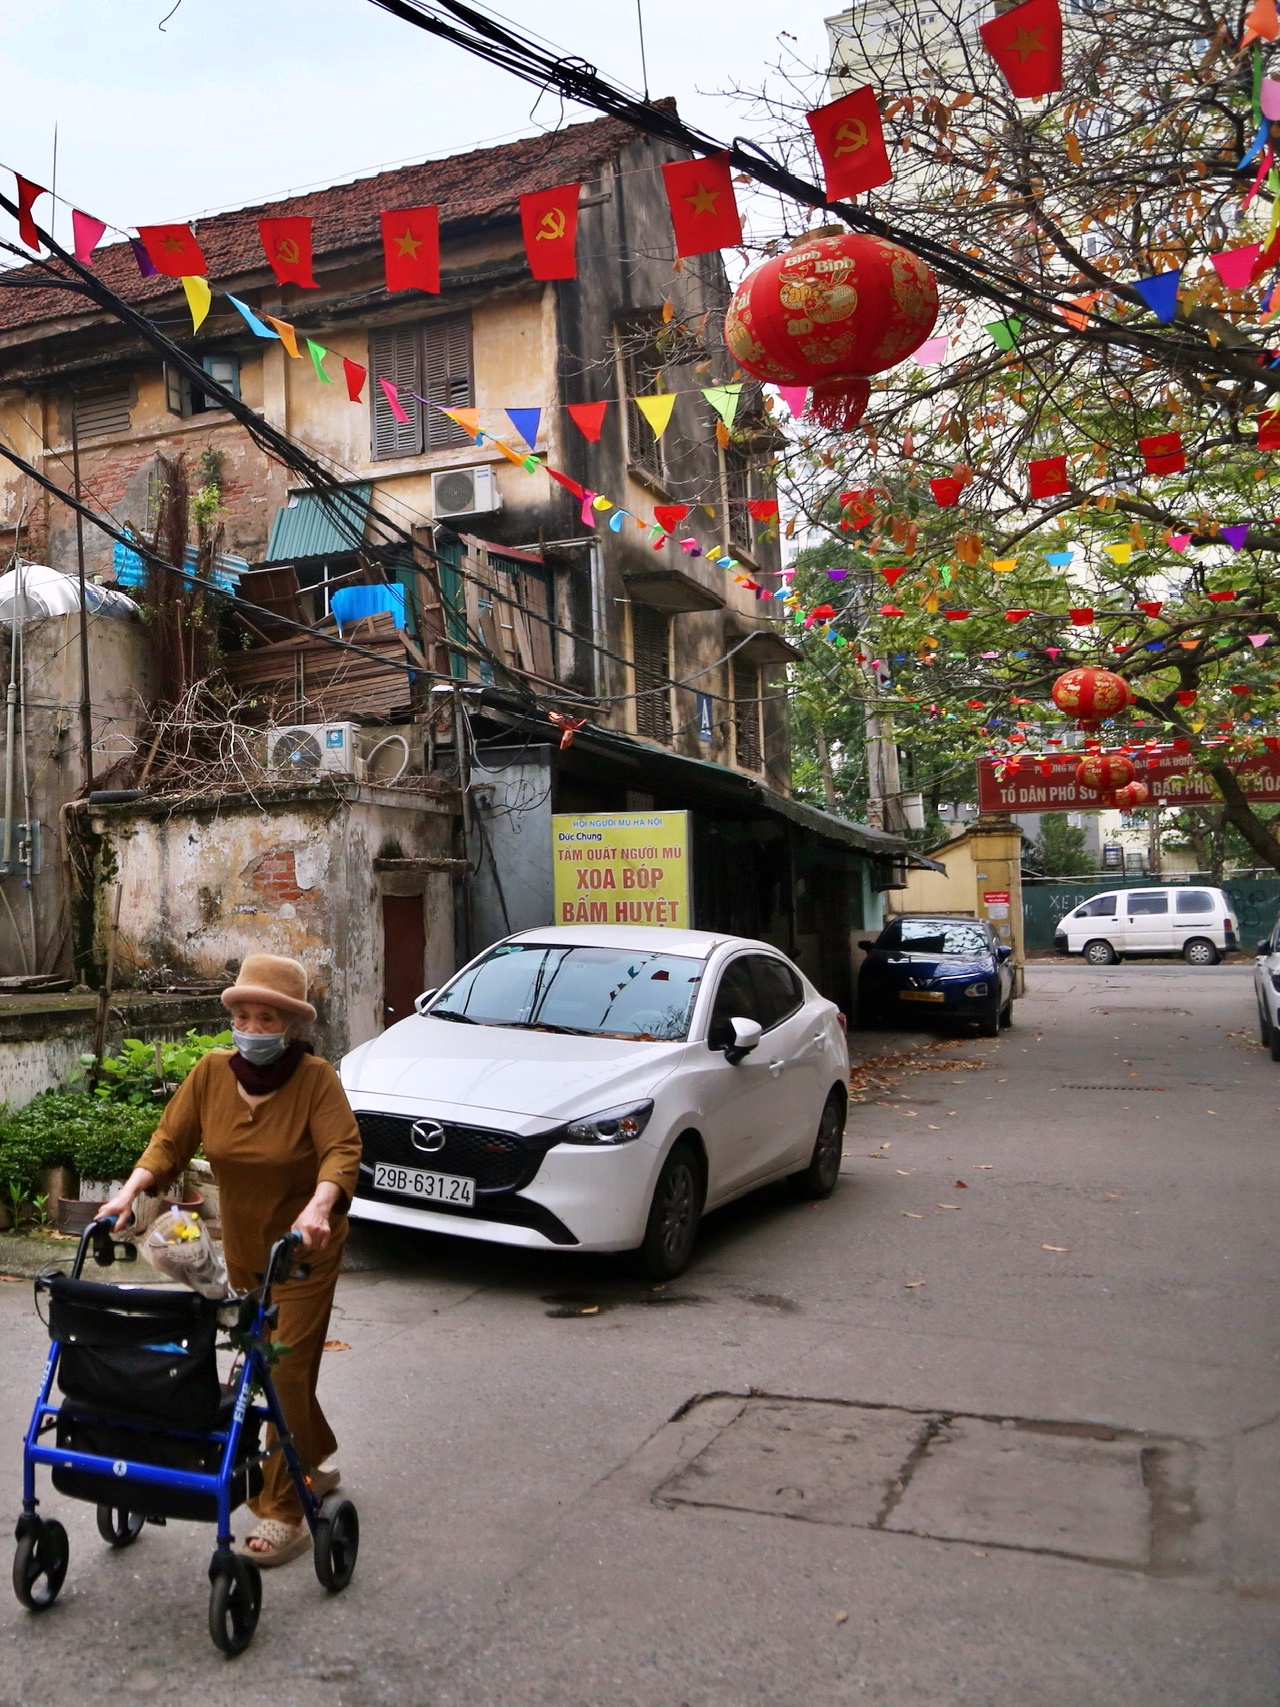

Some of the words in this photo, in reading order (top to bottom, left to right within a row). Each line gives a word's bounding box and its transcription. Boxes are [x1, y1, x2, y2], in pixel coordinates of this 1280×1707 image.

[1000, 782, 1016, 803] TỔ
[1020, 785, 1046, 803] DÂN
[1049, 781, 1076, 801] PHỐ
[558, 832, 574, 840] Đức
[576, 832, 602, 841] Chung
[621, 845, 658, 860] NGƯỜI
[576, 868, 616, 889] XOA
[623, 864, 664, 889] BÓP
[562, 894, 608, 923] BẤM
[615, 896, 679, 927] HUYỆT
[376, 1167, 470, 1202] 29B-631.24
[233, 1383, 249, 1424] Elite
